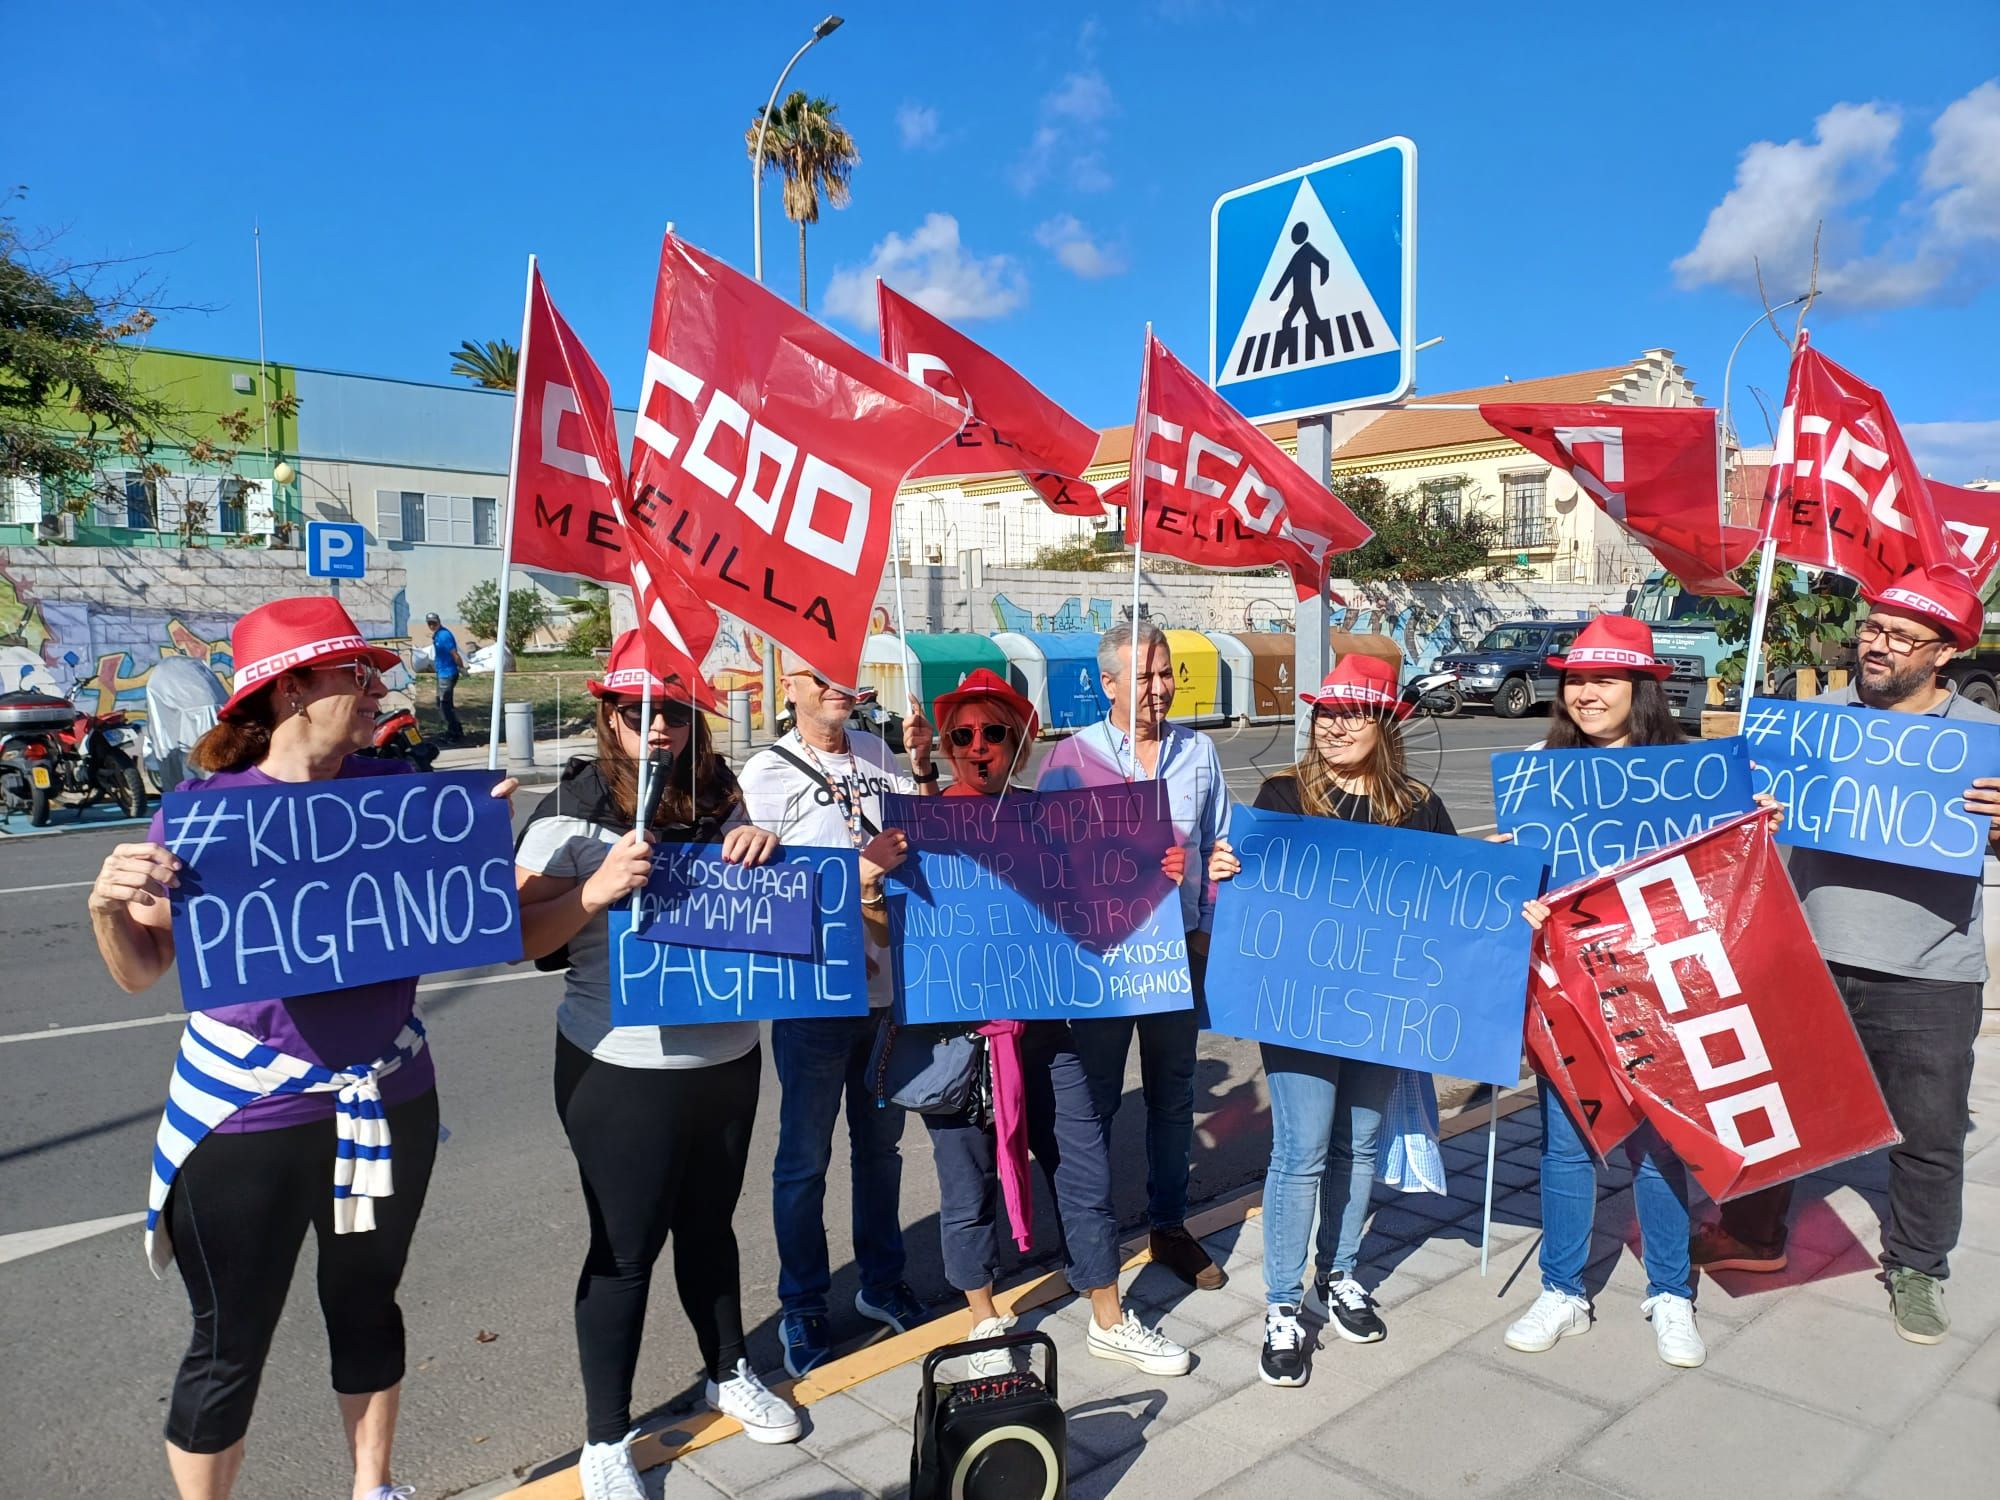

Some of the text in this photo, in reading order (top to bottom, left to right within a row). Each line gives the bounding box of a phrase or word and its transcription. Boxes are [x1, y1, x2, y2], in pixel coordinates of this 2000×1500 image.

[635, 349, 872, 576] CCOO
[320, 529, 353, 571] P
[629, 480, 837, 642] ELILLA
[244, 652, 299, 683] CCOO
[1592, 651, 1637, 663] CCOO
[1745, 706, 1969, 774] #KIDSCO
[813, 771, 891, 807] adidas
[1498, 752, 1728, 817] #KIDSCO
[166, 784, 475, 868] #KIDSCO
[889, 792, 1145, 844] NUESTRO TRABAJO
[925, 852, 1017, 890] CUIDAR
[1039, 853, 1076, 889] DE
[1091, 848, 1138, 887] LOS
[1232, 833, 1521, 932] SOLO EXIGIMOS
[188, 857, 513, 988] PÁGANOS
[684, 892, 772, 935] MAMÁ
[987, 903, 1020, 936] EL
[1102, 940, 1186, 967] #KIDSCO
[1239, 906, 1445, 988] LO QUE ES
[898, 940, 1105, 1020] PAGARNOS
[1110, 966, 1192, 1004] PÁGANOS
[1614, 853, 1801, 1168] CCOO
[1255, 976, 1461, 1062] NUESTRO
